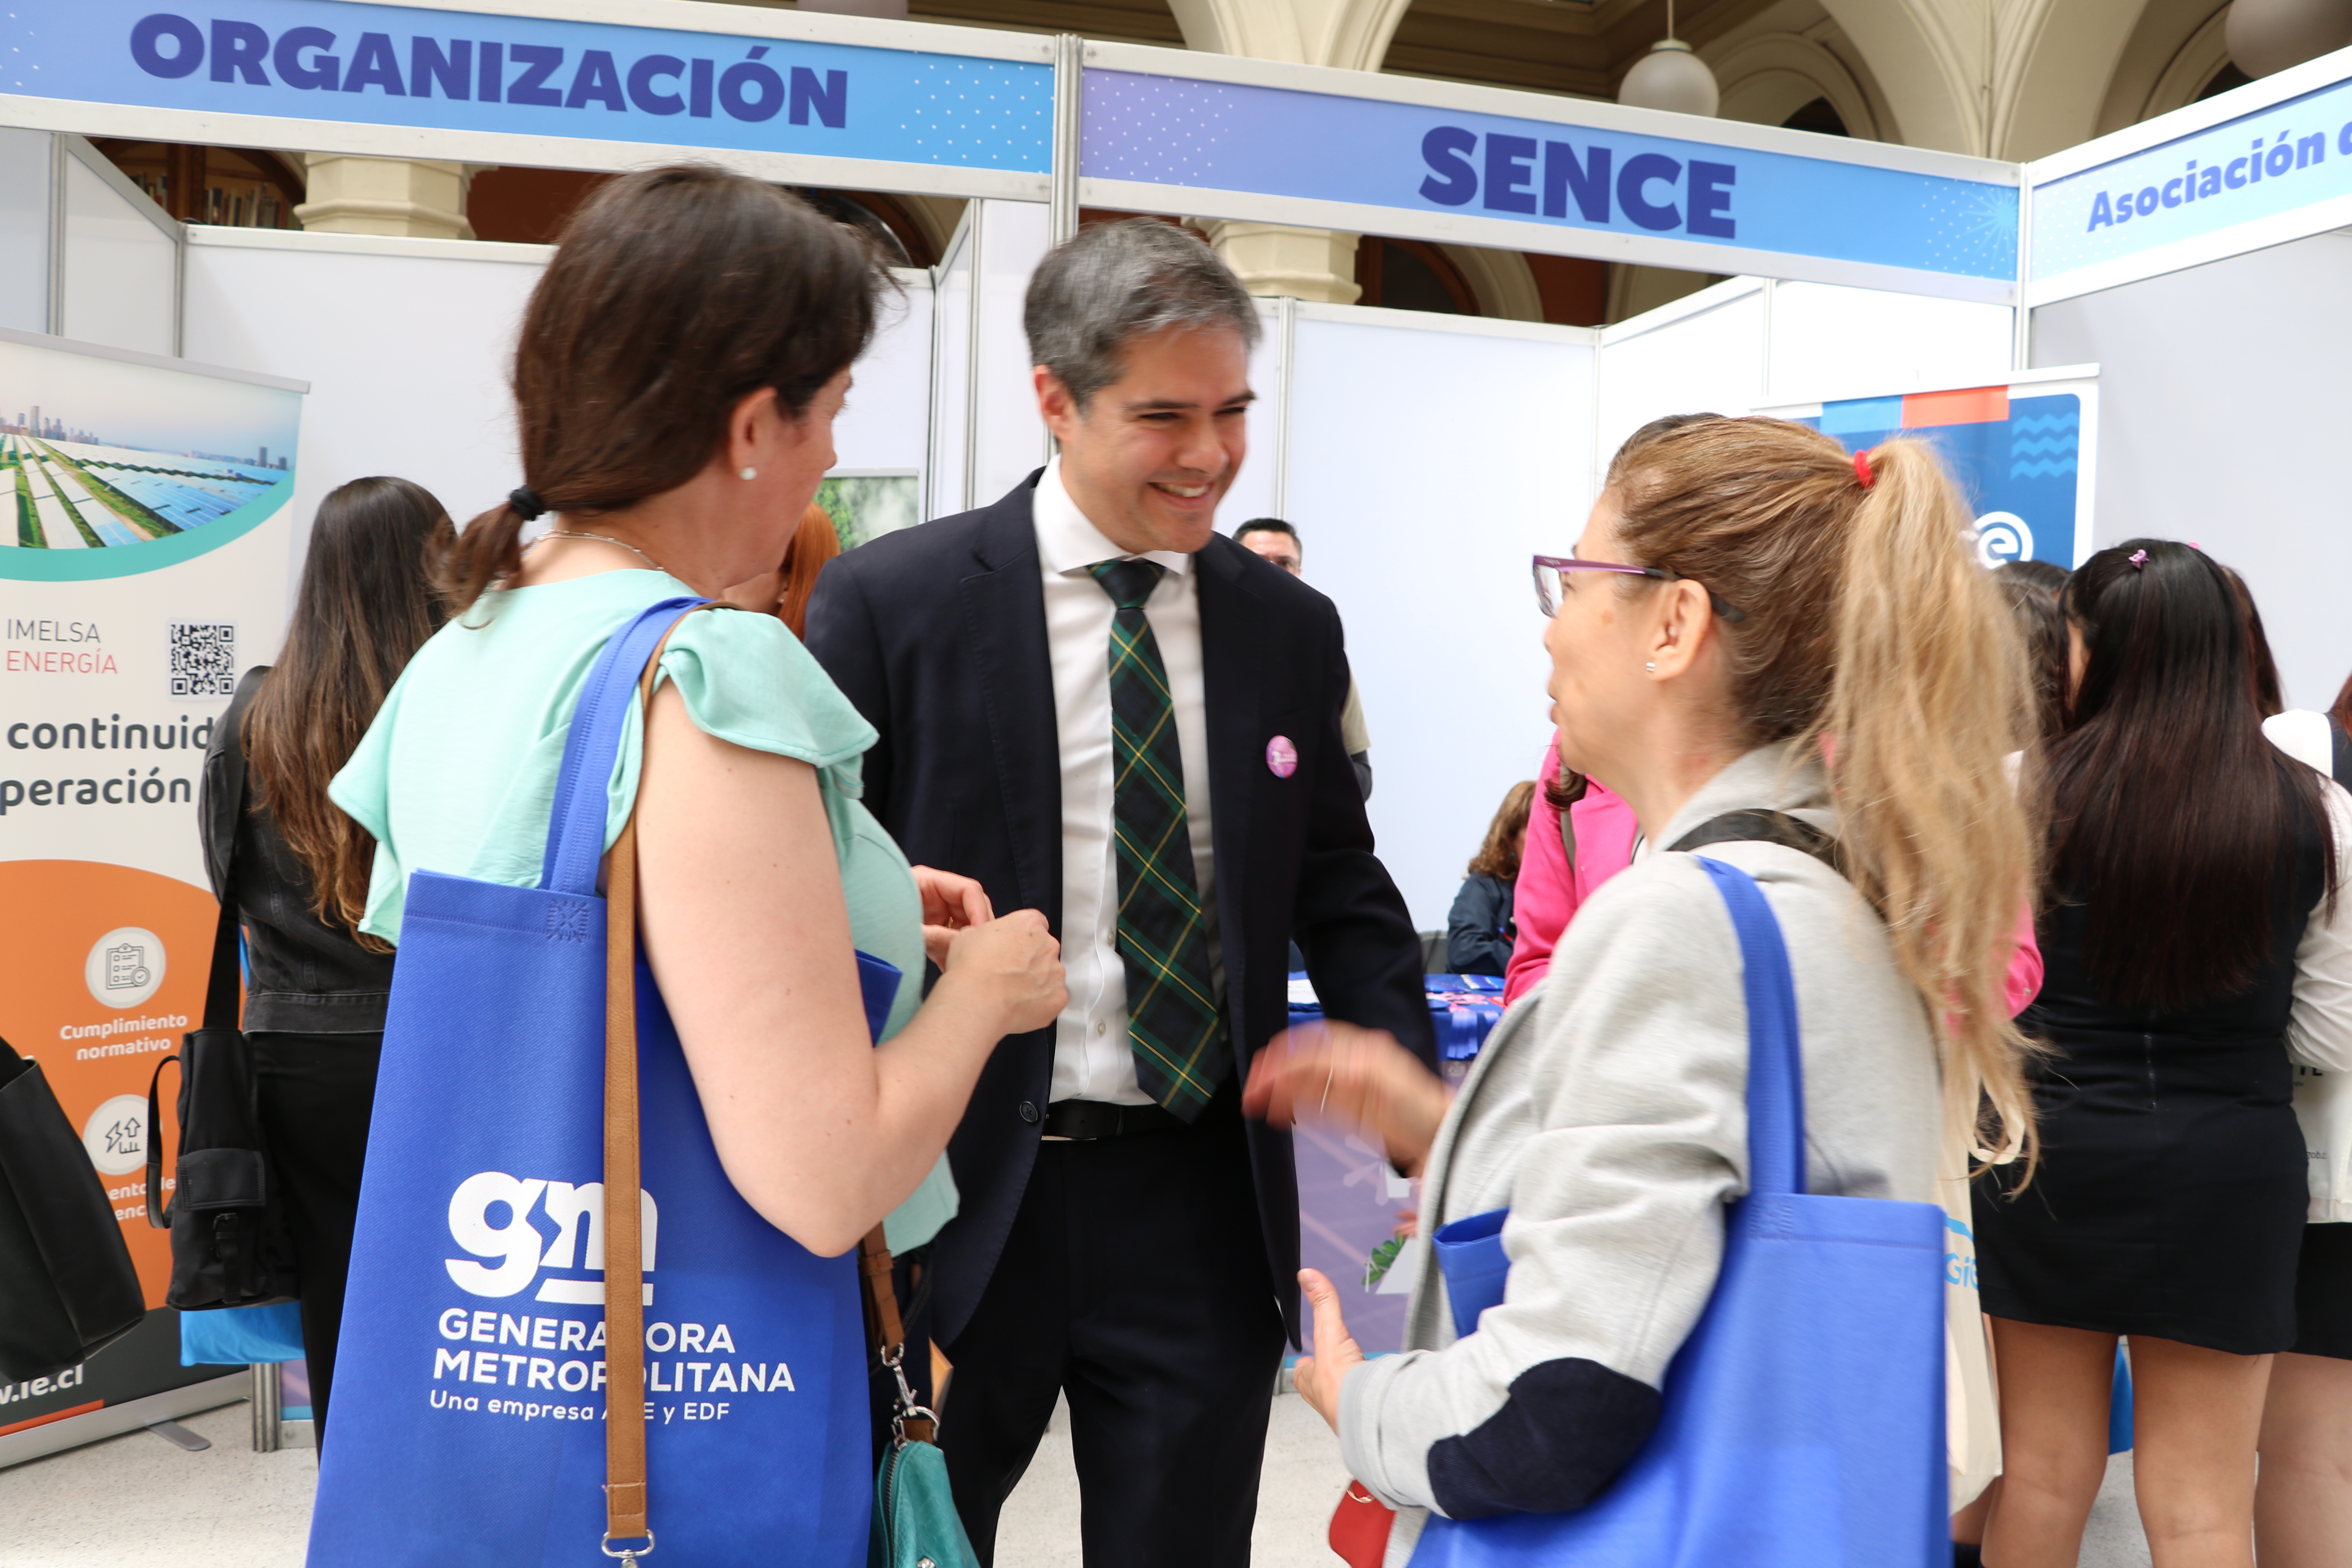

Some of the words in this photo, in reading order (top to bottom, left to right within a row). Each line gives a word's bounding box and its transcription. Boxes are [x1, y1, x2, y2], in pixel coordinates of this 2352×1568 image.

[131, 13, 848, 129] ORGANIZACIÓN
[1418, 125, 1736, 239] SENCE
[2087, 129, 2326, 233] Asociación
[7, 619, 101, 643] IMELSA
[6, 648, 118, 674] ENERGÍA
[60, 1014, 188, 1040] Cumplimiento
[76, 1036, 172, 1060] normativo
[107, 1182, 147, 1201] ento
[439, 1307, 736, 1353] GENERAORA
[434, 1348, 795, 1392] METROPLITANA
[430, 1389, 479, 1412] Una
[488, 1399, 594, 1421] empresa
[663, 1406, 675, 1425] y
[684, 1402, 730, 1420] EDF
